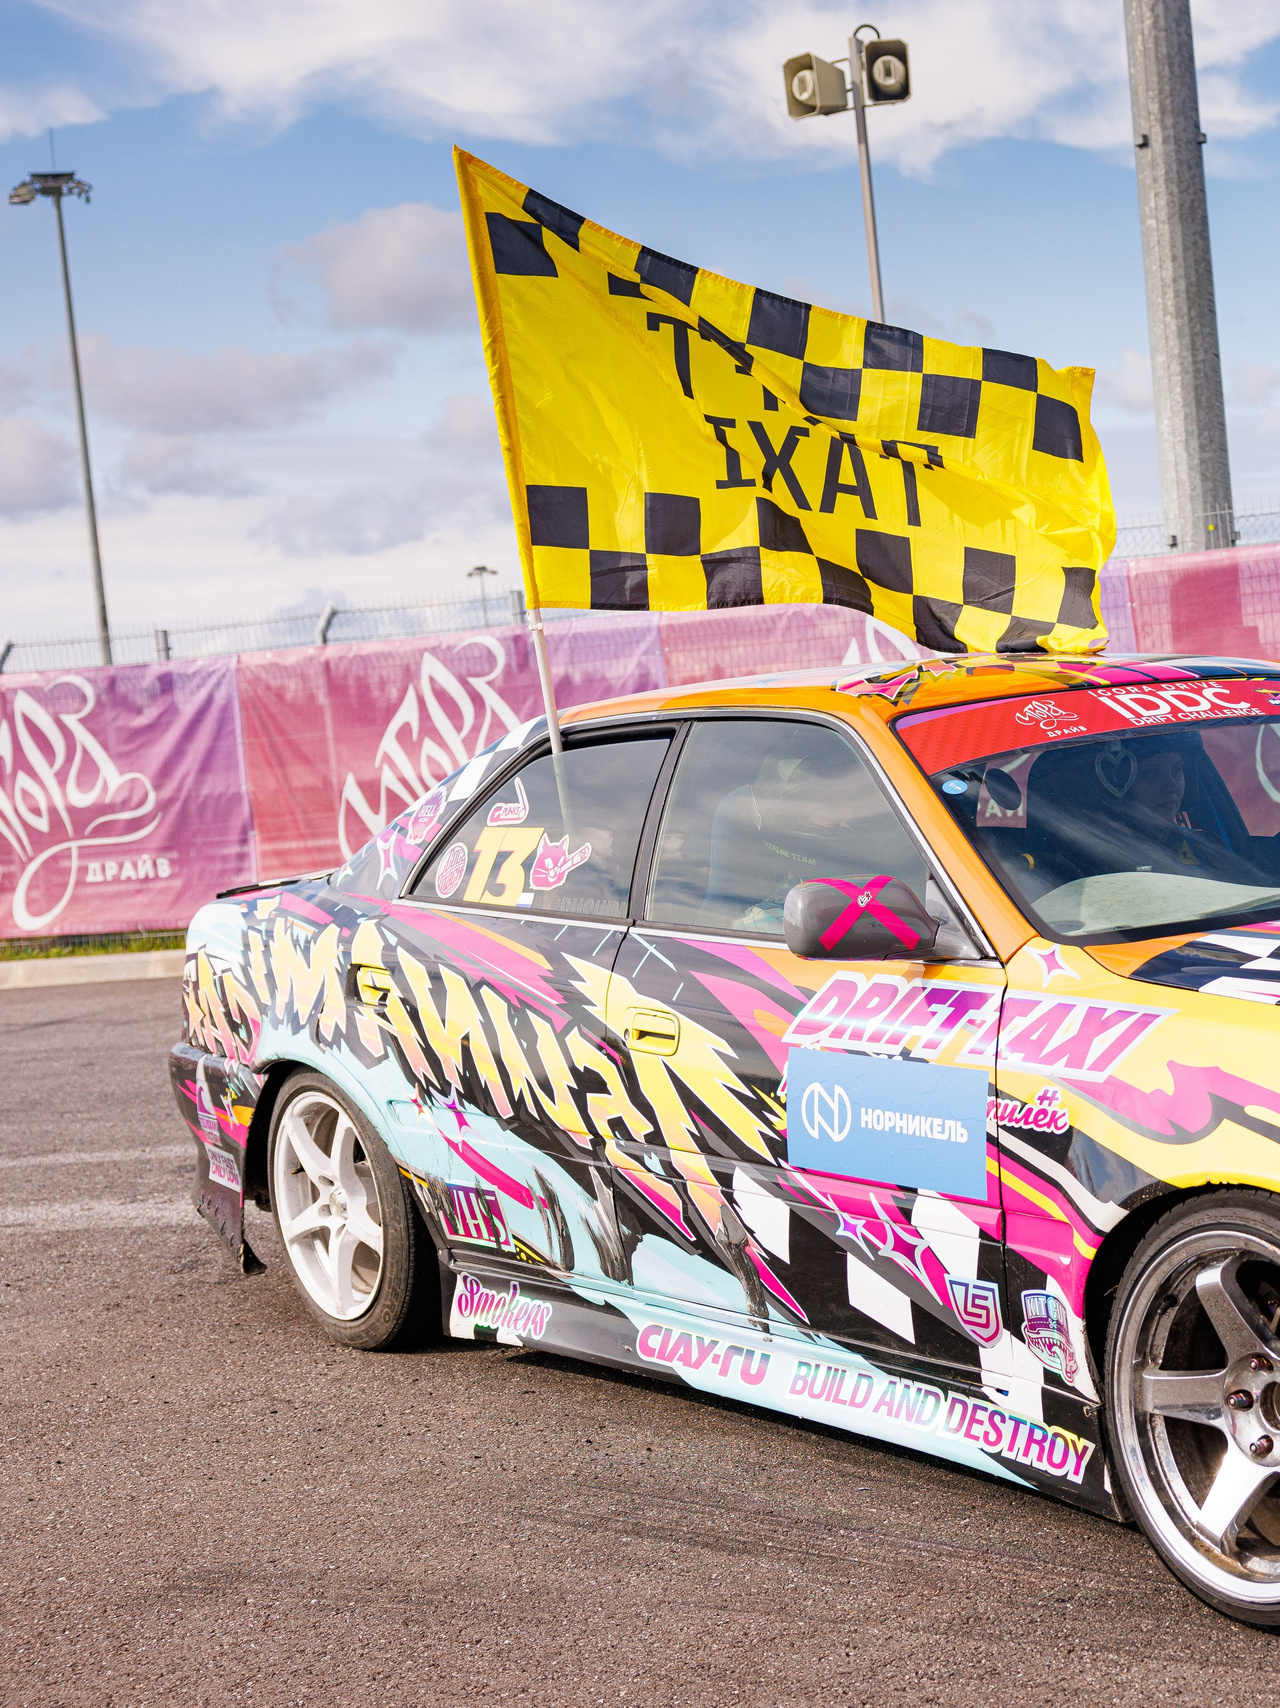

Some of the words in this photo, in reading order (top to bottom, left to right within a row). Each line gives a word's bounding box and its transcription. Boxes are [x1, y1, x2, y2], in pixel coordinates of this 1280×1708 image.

[1088, 683, 1157, 698] IGORA
[1159, 681, 1224, 694] DRIVE
[1097, 688, 1252, 720] IDDC
[1046, 725, 1088, 738] ДРАЙВ
[1129, 713, 1179, 727] DRIFT
[1176, 707, 1266, 724] CHALLENGE
[85, 853, 173, 883] ДРАЙВ
[463, 827, 545, 907] 13
[799, 978, 995, 1050] DRIFT
[968, 997, 1162, 1072] TAXI
[860, 1106, 969, 1144] НОРНИКЕЛЬ
[457, 1274, 551, 1336] Smokers
[789, 1361, 874, 1410] BUILD
[872, 1379, 940, 1426] AND
[945, 1400, 1091, 1478] DESTROY
